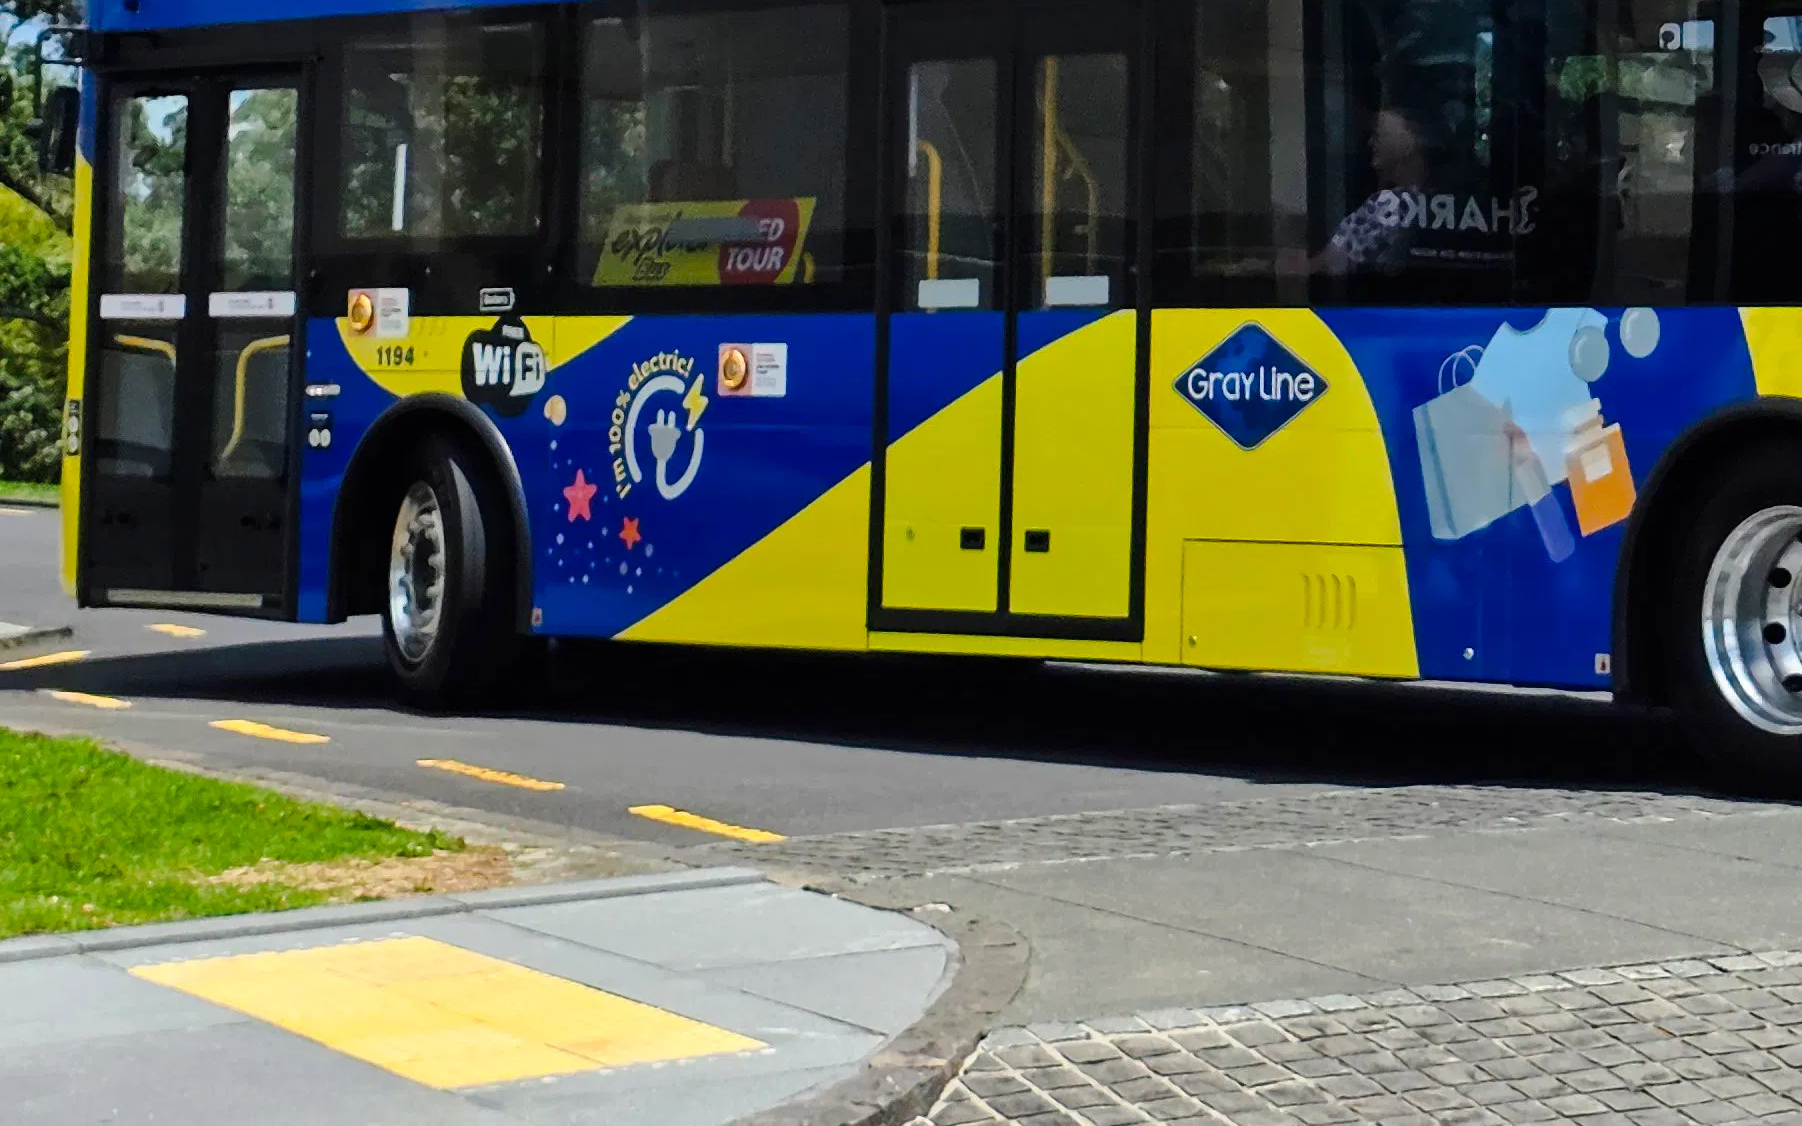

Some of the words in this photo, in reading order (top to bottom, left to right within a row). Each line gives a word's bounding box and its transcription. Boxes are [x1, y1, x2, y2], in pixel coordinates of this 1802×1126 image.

[725, 246, 785, 272] TOUR
[376, 345, 415, 367] 1194
[608, 390, 632, 456] 100%
[627, 348, 695, 392] electric!
